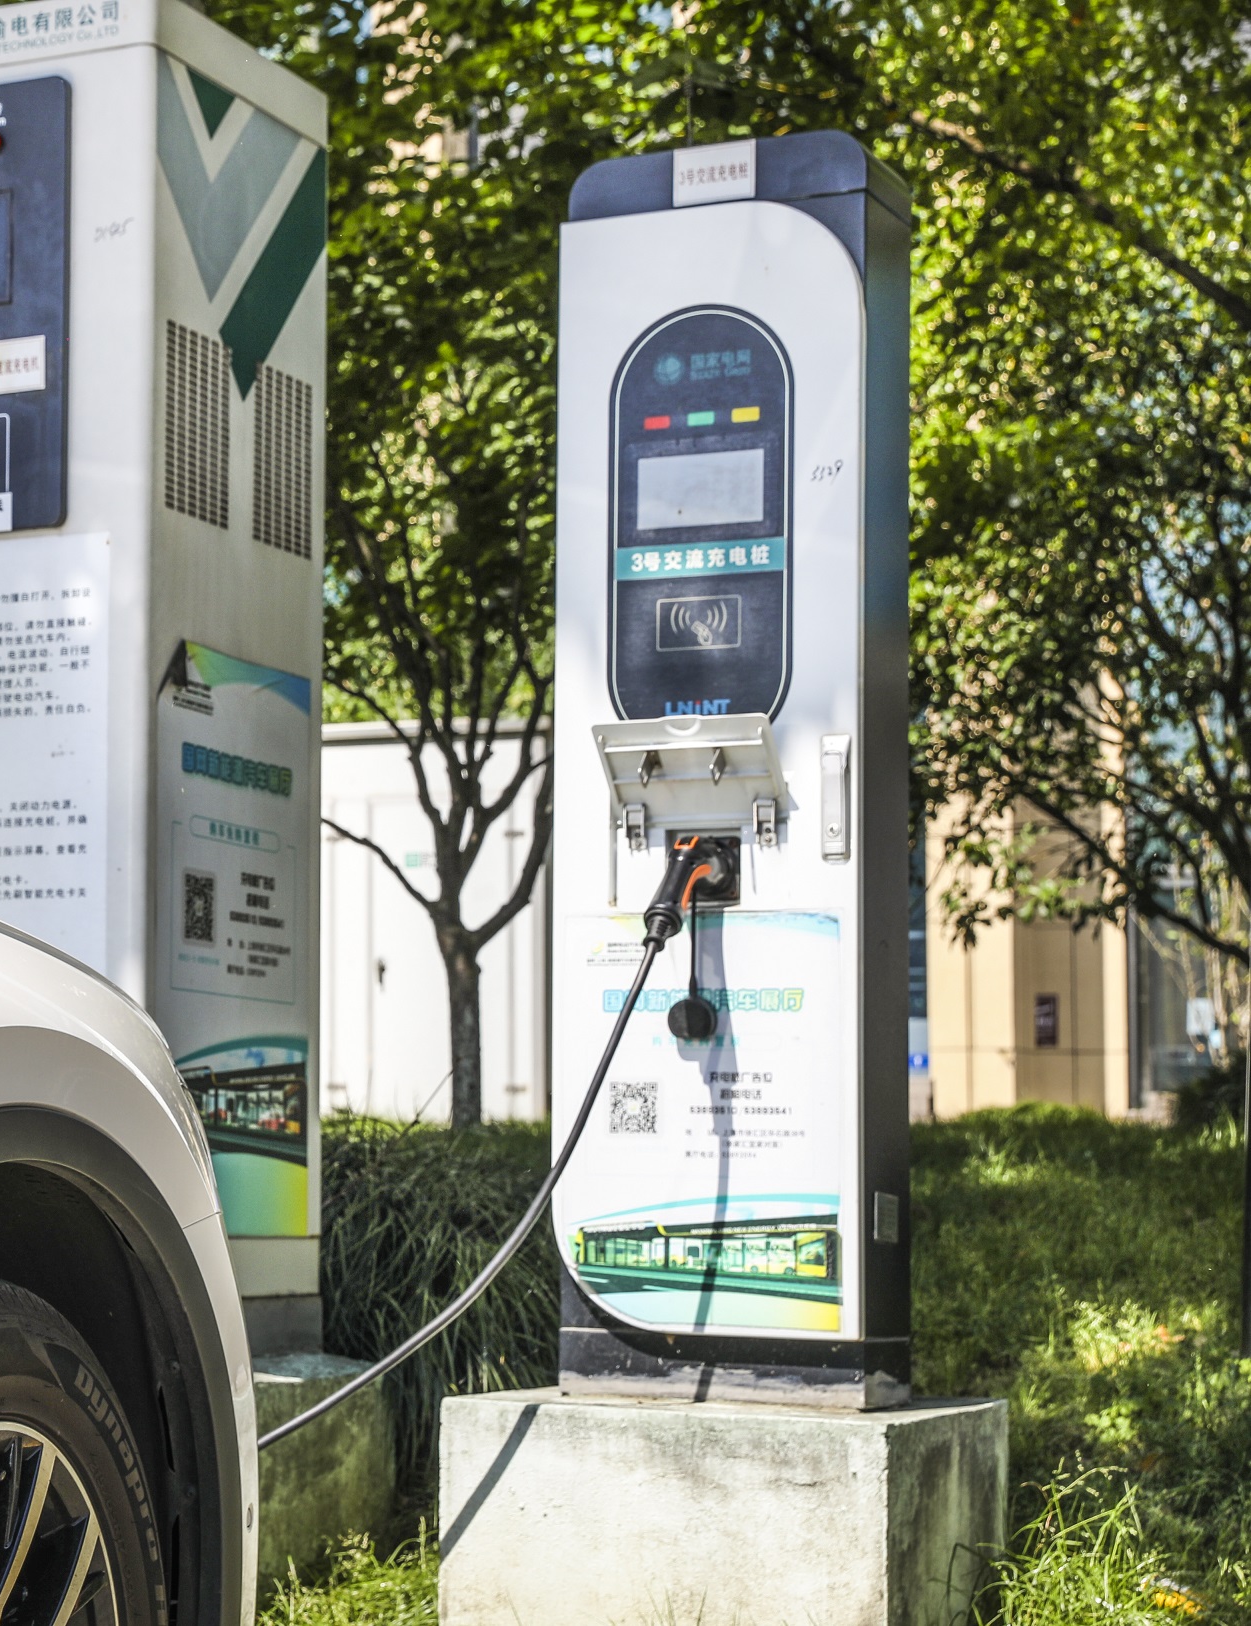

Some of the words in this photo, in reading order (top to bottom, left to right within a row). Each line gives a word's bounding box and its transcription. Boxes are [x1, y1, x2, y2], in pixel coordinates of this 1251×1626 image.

[631, 544, 770, 572] 3号交流充电桩
